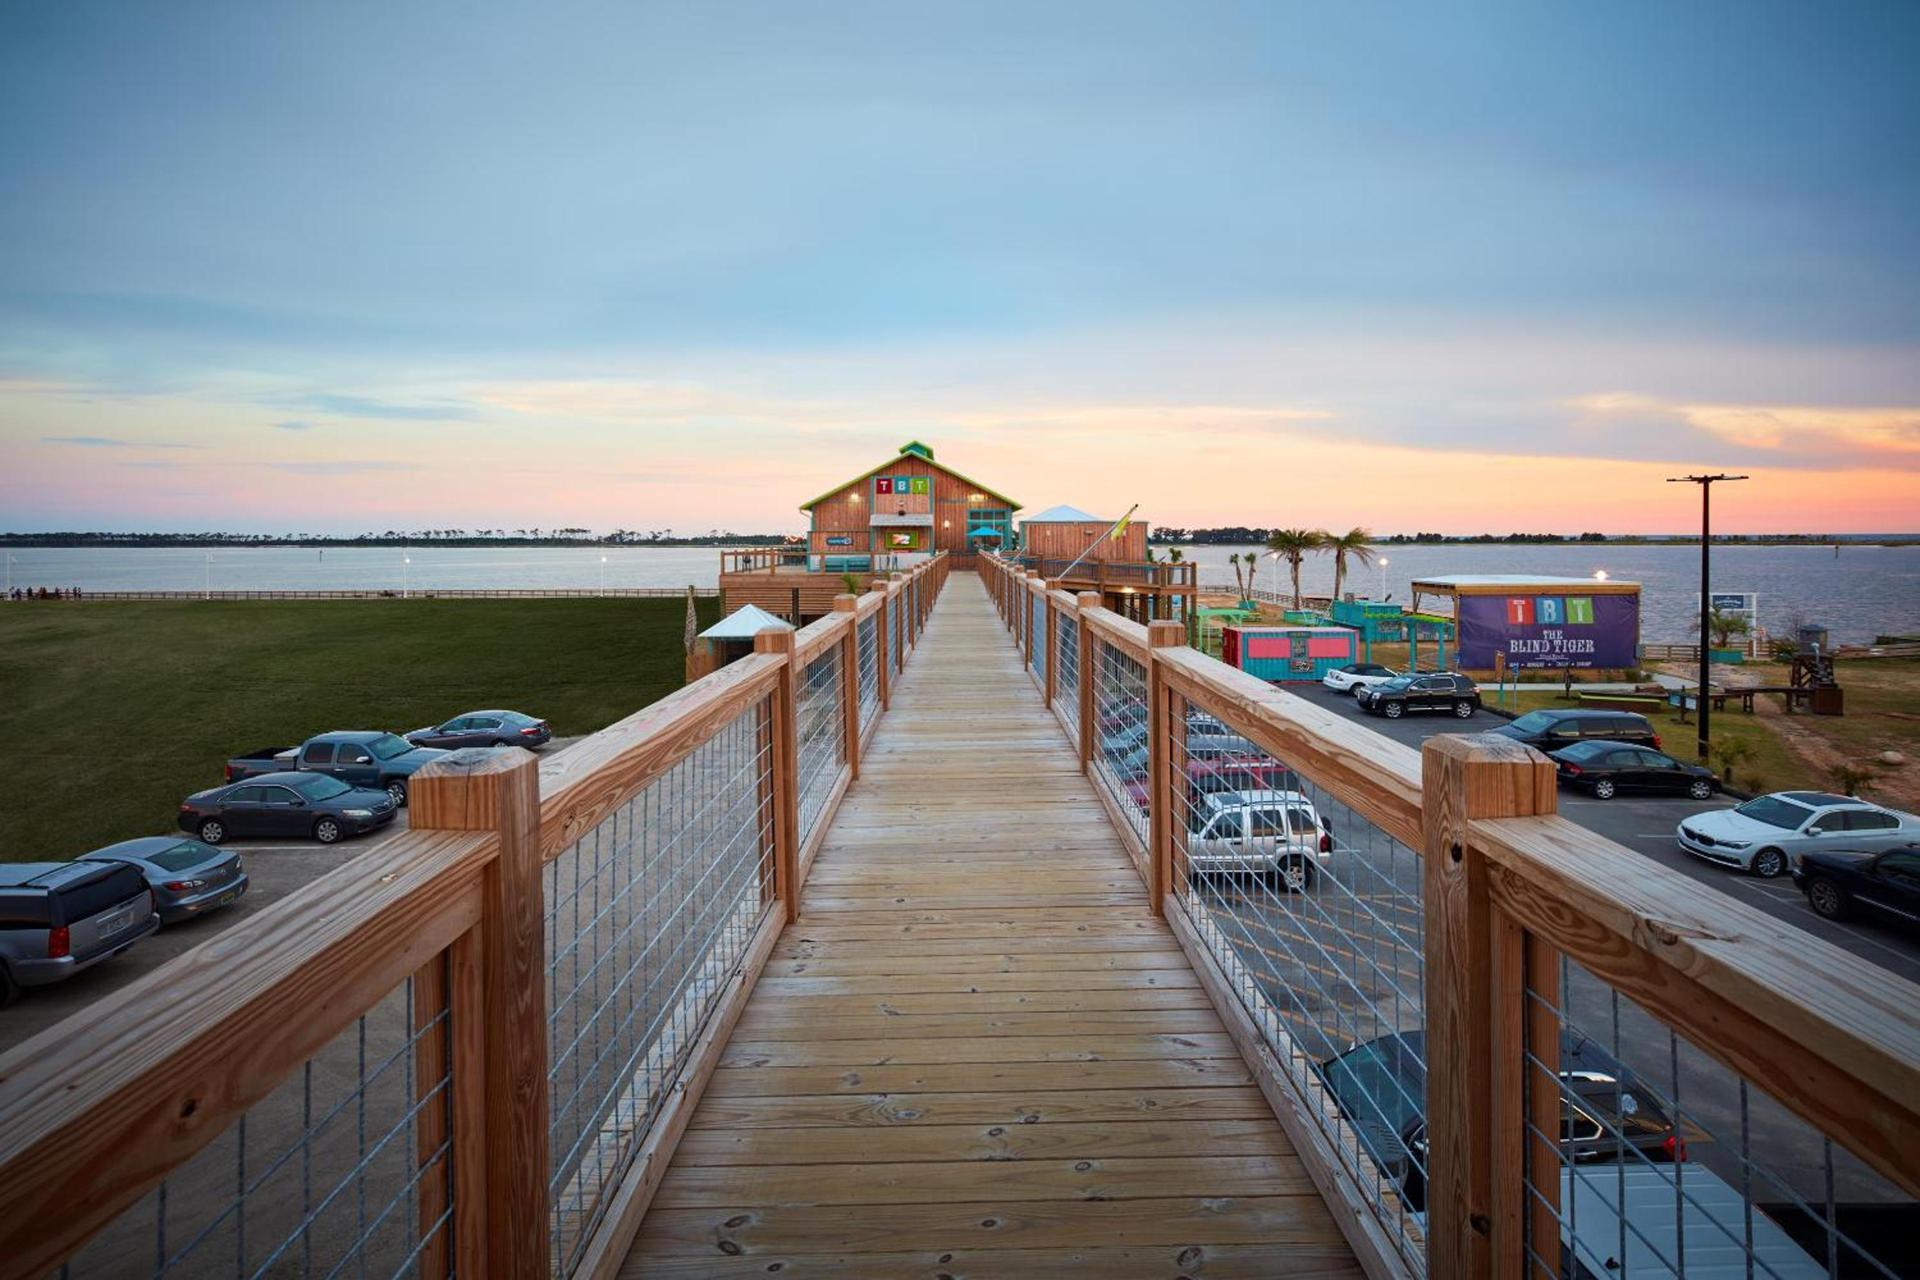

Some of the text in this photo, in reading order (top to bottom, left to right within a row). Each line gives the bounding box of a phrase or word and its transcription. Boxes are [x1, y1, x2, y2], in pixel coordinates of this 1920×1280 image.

[879, 480, 925, 492] TBT
[1512, 599, 1586, 623] TBT
[1542, 630, 1563, 640] THE
[1510, 639, 1595, 653] BLIND TIGER
